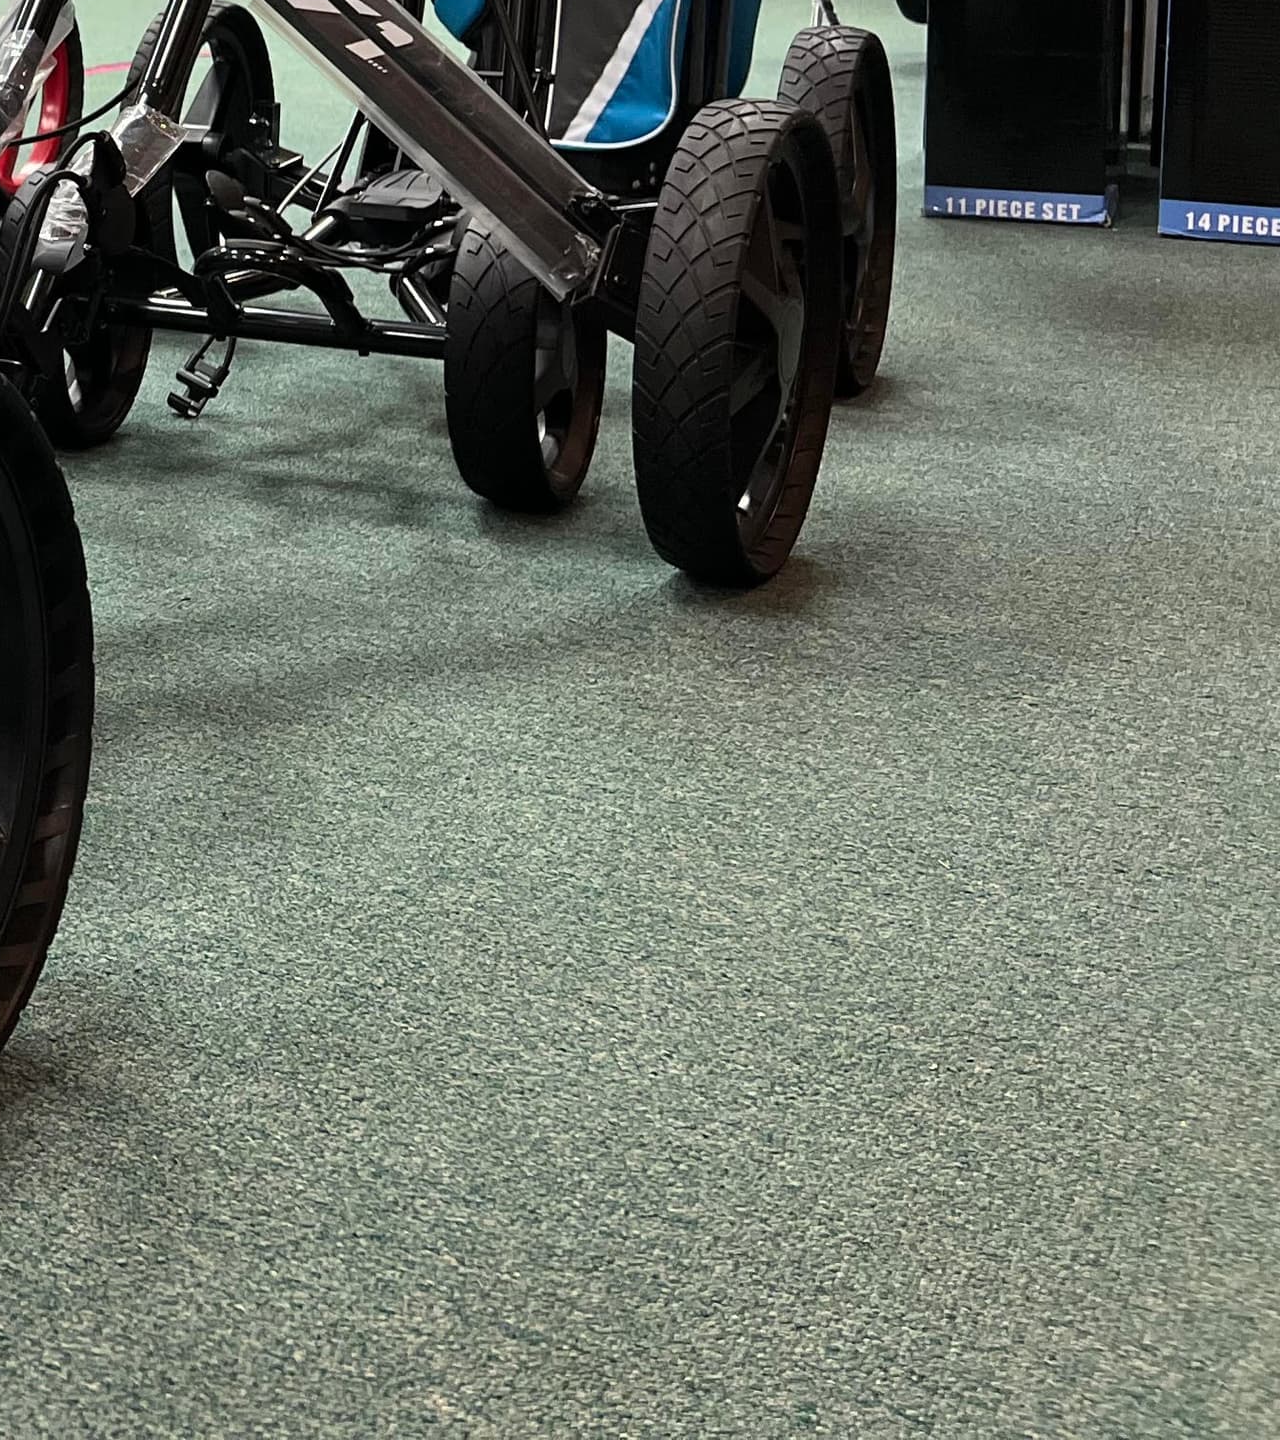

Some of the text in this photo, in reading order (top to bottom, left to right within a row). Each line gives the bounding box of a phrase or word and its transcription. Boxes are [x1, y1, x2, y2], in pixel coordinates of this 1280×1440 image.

[945, 197, 1081, 222] 11 PIECE SET
[1185, 211, 1280, 237] 14 PIECE
